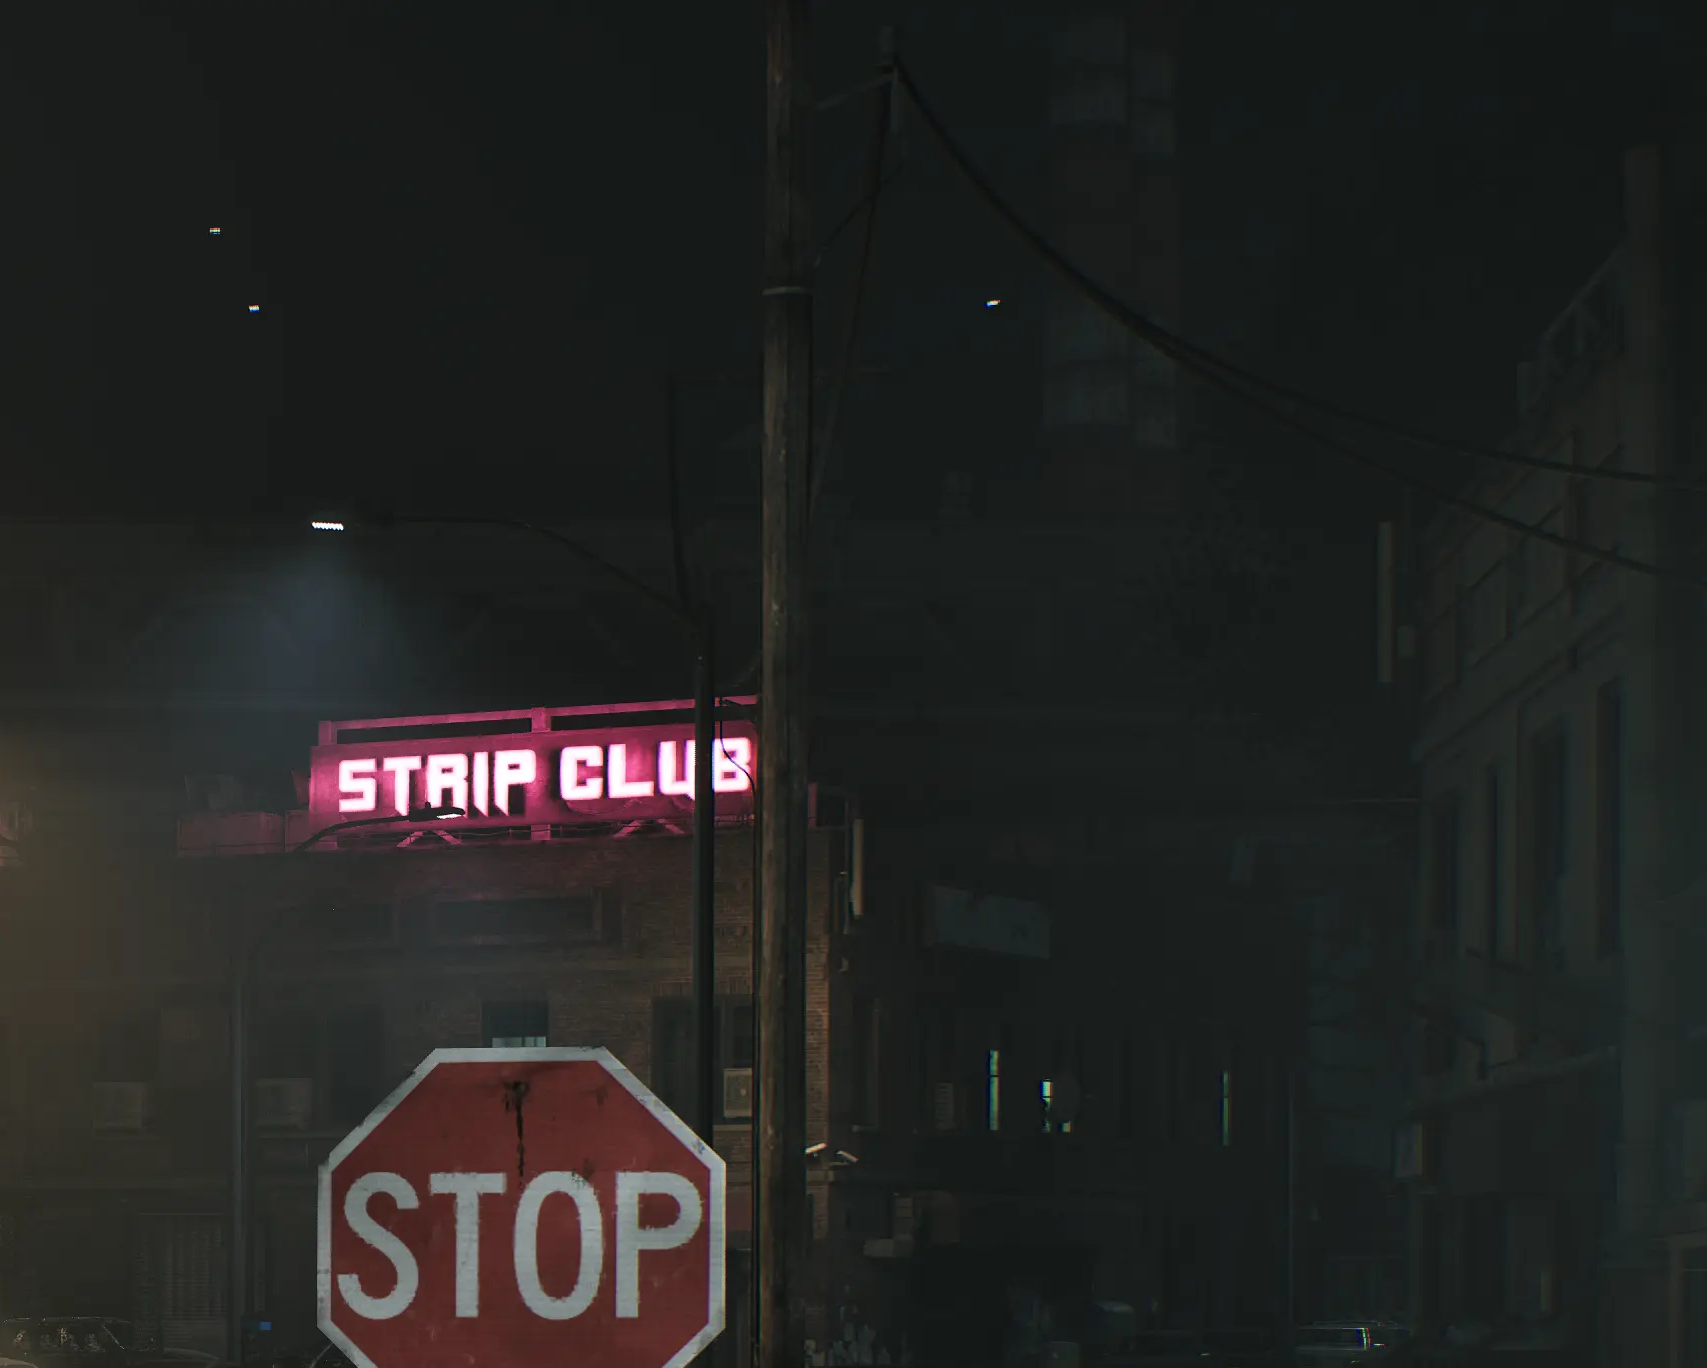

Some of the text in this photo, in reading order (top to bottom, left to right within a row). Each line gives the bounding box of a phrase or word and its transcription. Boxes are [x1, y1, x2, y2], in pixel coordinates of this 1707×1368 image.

[338, 736, 752, 817] STRIP CLUB
[337, 1171, 703, 1320] STOP
